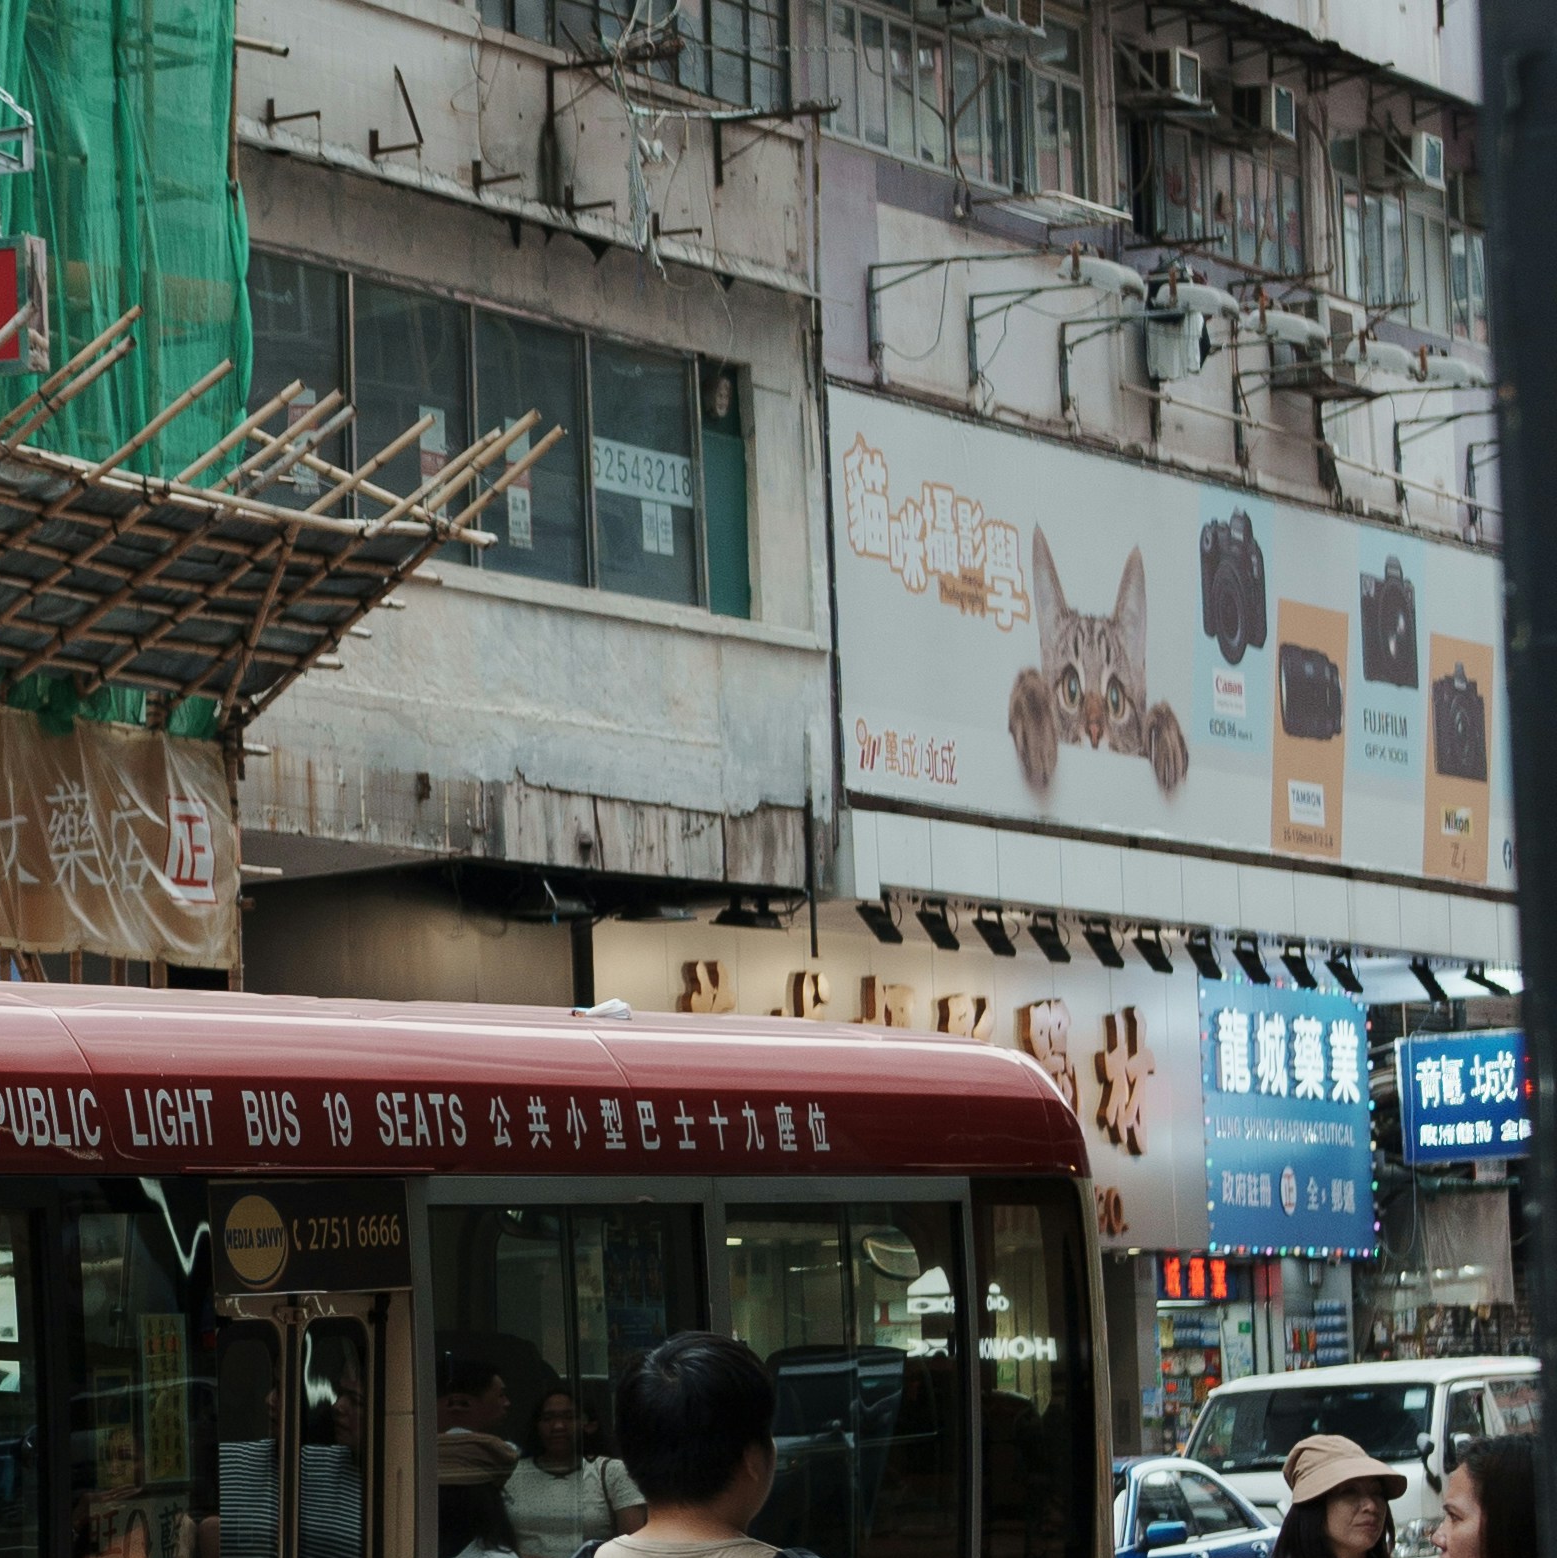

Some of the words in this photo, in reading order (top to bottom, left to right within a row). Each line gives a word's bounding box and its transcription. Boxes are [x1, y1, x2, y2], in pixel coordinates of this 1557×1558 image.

[1215, 675, 1243, 697] Canon
[1363, 707, 1408, 739] FUJIFILM
[1444, 809, 1470, 834] Nikon
[171, 812, 209, 889] 正
[1218, 1006, 1361, 1104] 龍城藥業
[126, 1088, 215, 1150] LIGHT
[240, 1090, 301, 1149] BUS
[322, 1092, 353, 1149] 19
[376, 1093, 467, 1150] SEATS
[488, 1096, 831, 1153] 公共小型巴士十九座位
[225, 1221, 255, 1251] MEDIA
[256, 1222, 285, 1251] SAVVY
[308, 1215, 352, 1250] 2751
[356, 1212, 401, 1248] 6666
